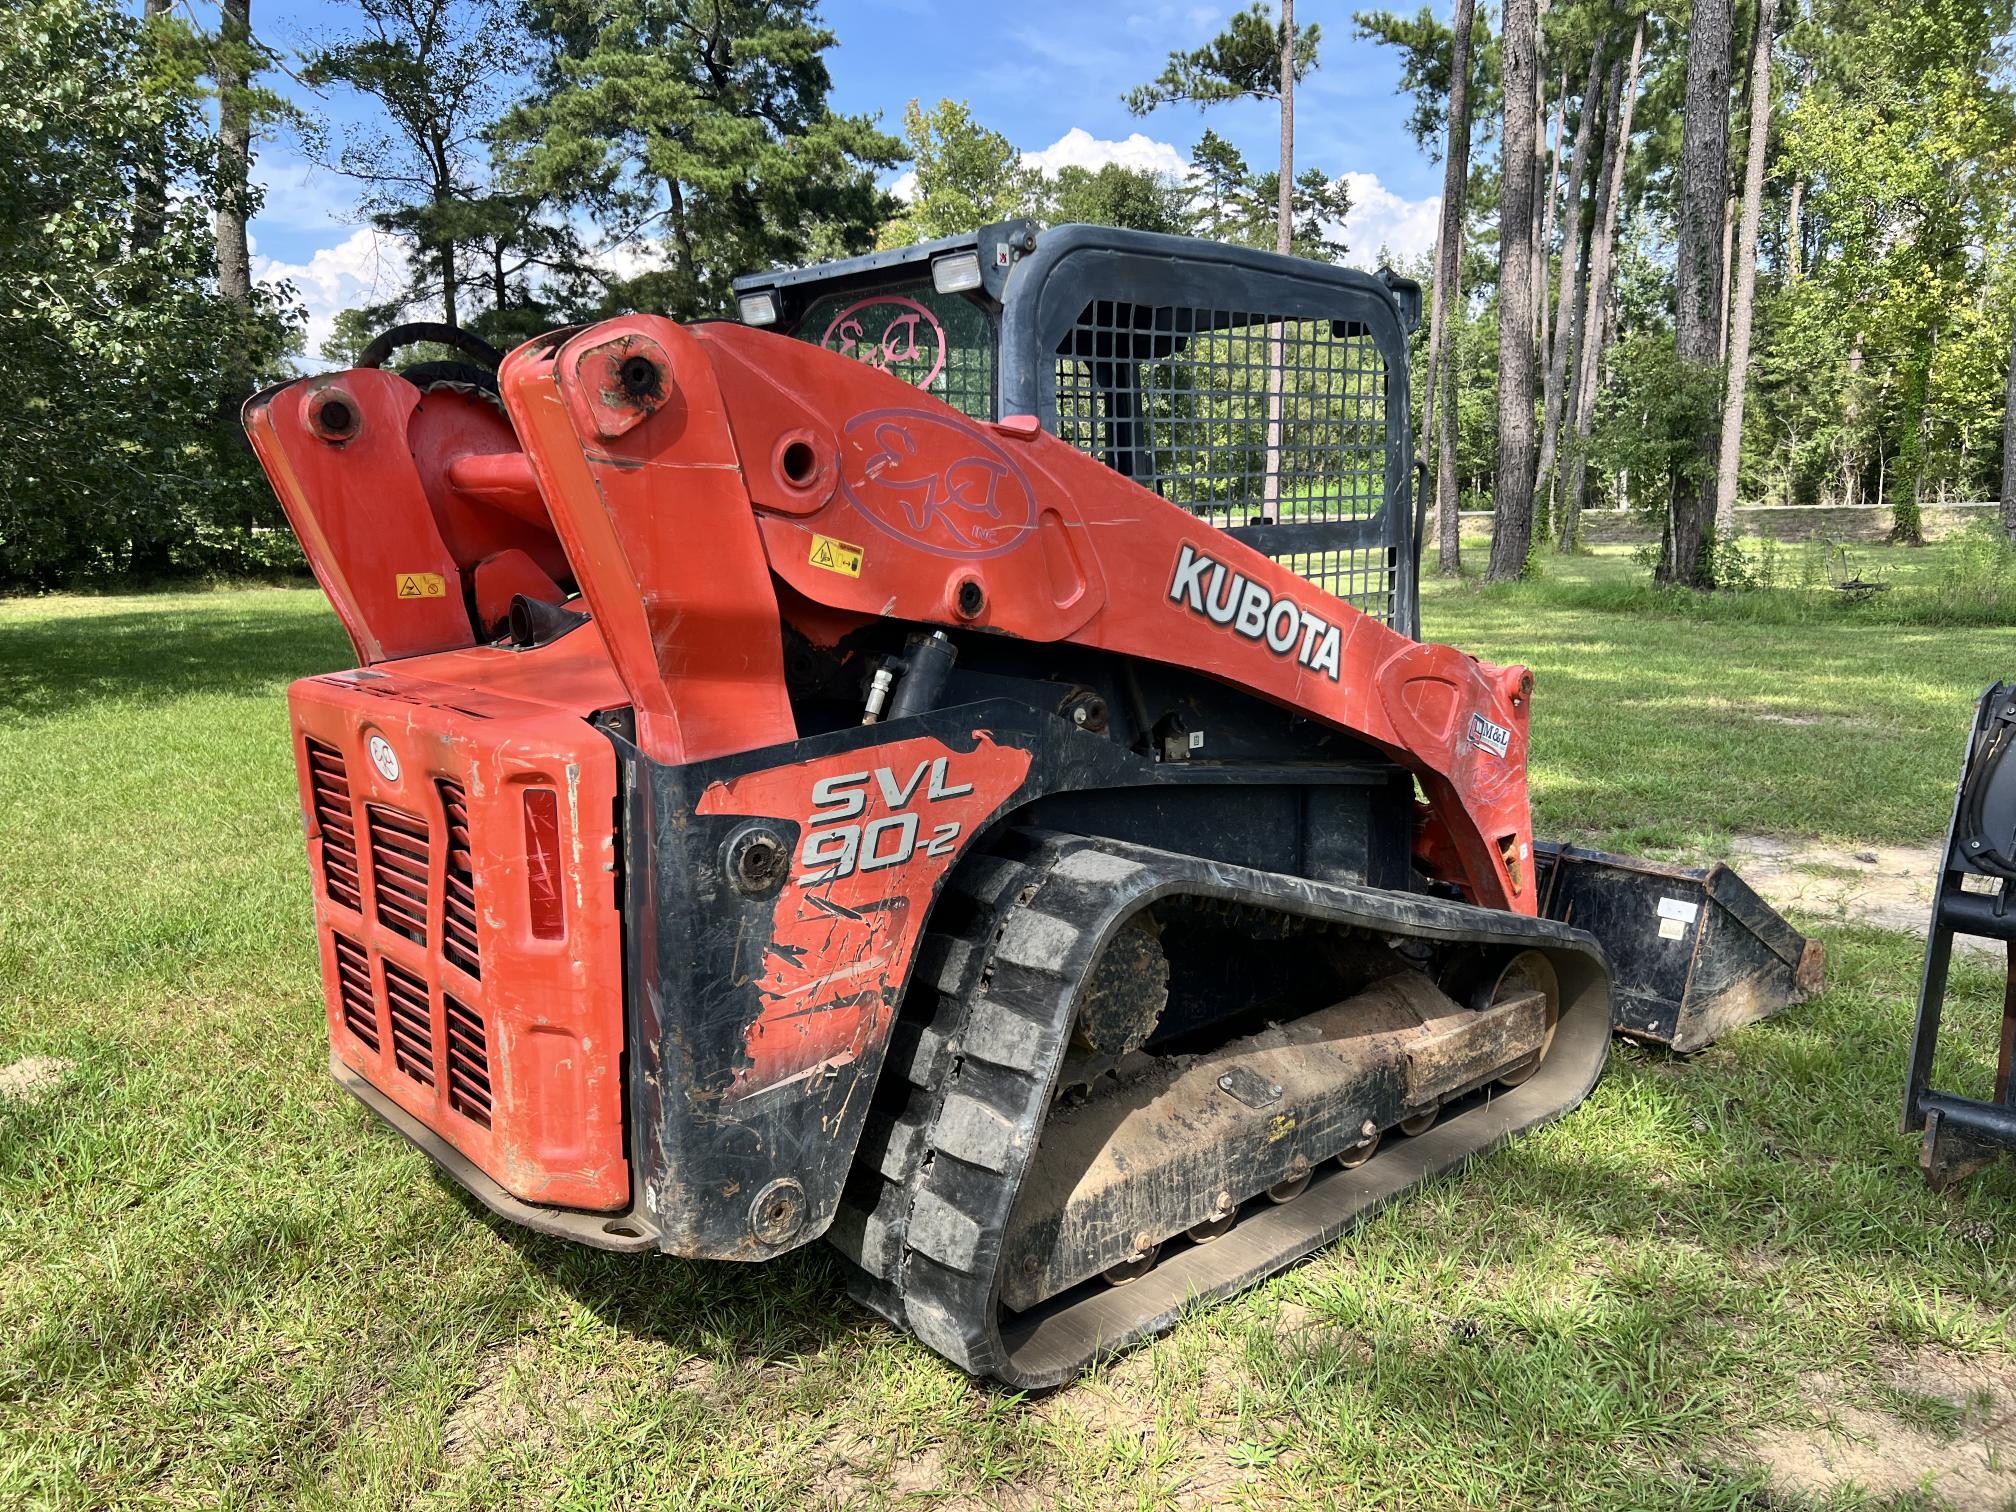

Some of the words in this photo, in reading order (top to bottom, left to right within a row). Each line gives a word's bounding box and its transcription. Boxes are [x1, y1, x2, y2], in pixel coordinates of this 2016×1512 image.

[1169, 545, 1342, 681] KUBOTA
[1482, 723, 1508, 746] M&L
[808, 756, 973, 826] SVL
[797, 812, 961, 888] 90-2
